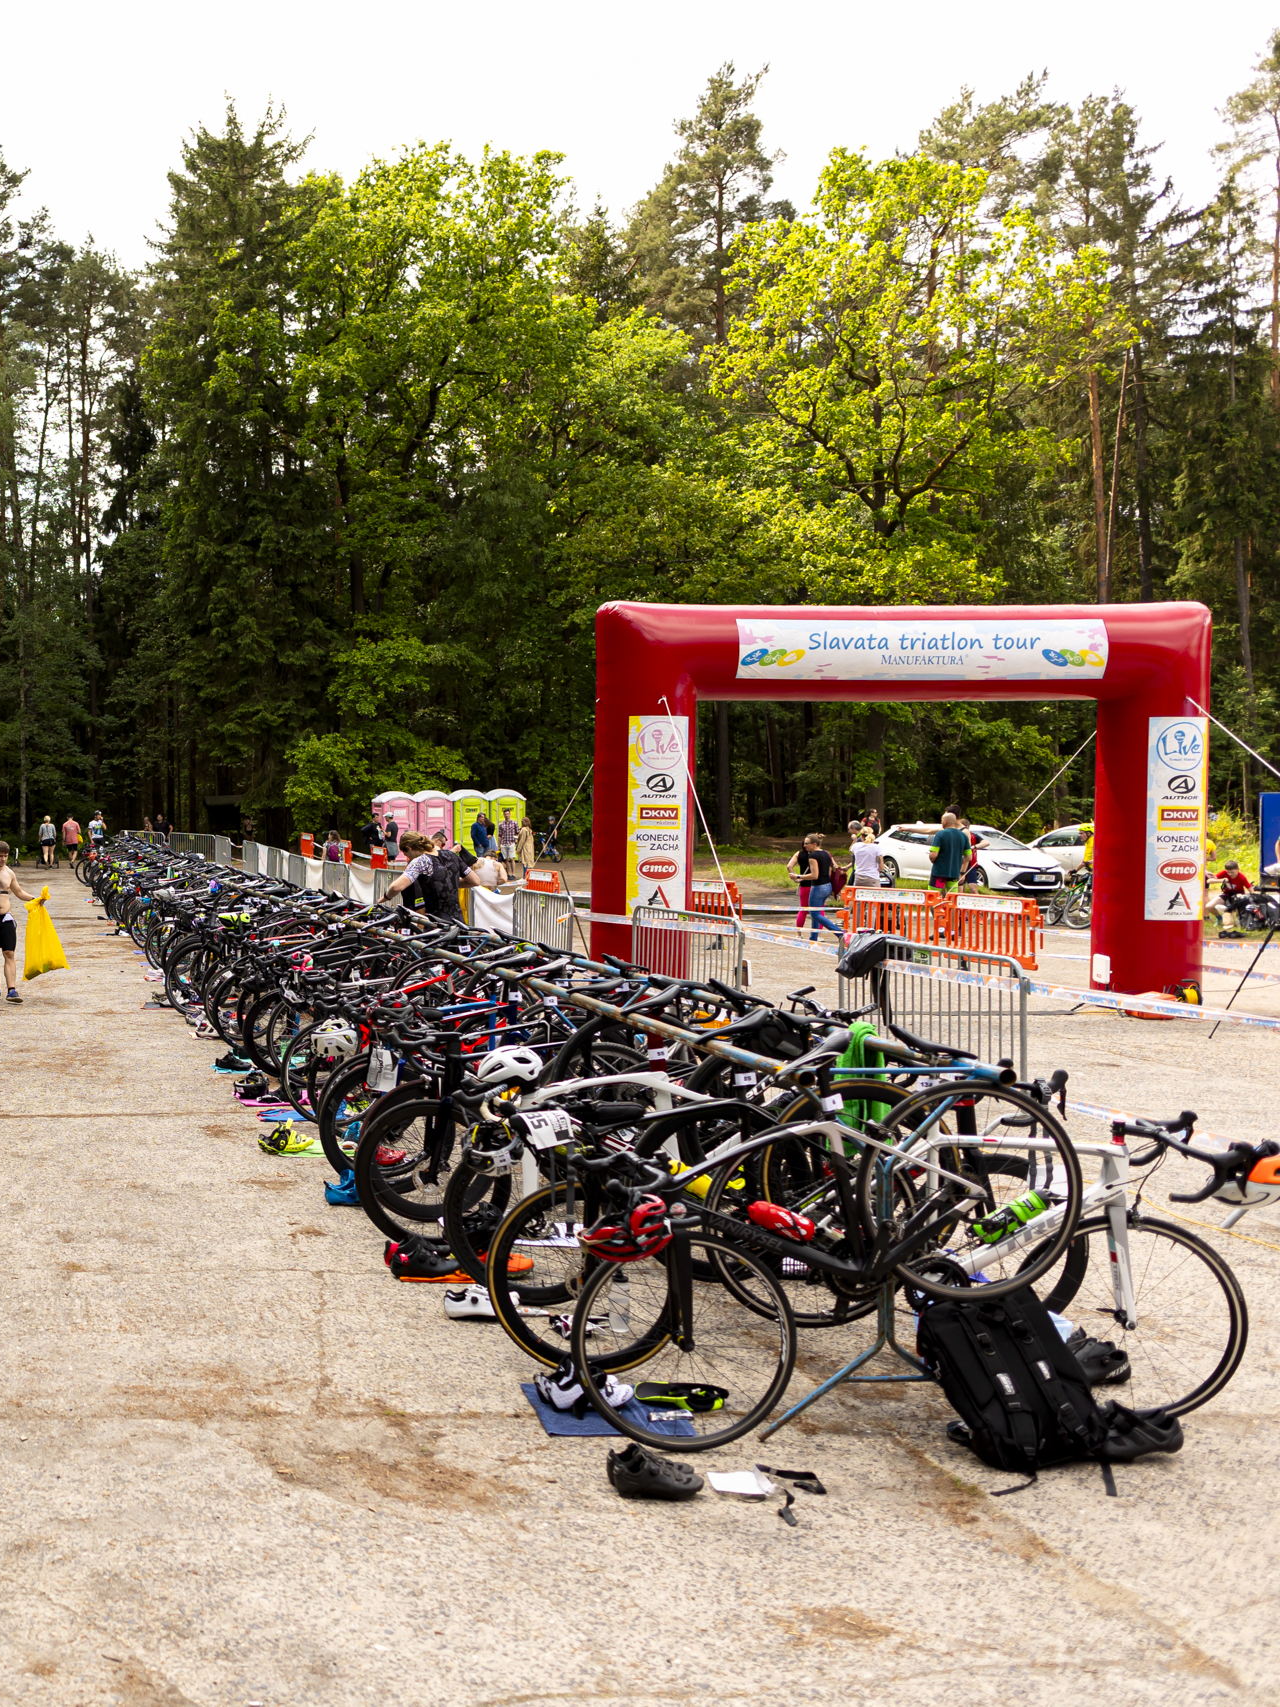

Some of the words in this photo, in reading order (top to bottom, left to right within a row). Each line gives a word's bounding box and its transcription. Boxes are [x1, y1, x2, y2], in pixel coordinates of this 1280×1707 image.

[808, 631, 889, 651] Slavata
[898, 631, 984, 651] triatlon
[991, 633, 1042, 651] tour
[642, 809, 677, 818] DKNV
[1163, 811, 1198, 819] DKNV
[641, 864, 676, 873] emco
[1162, 865, 1196, 875] emco
